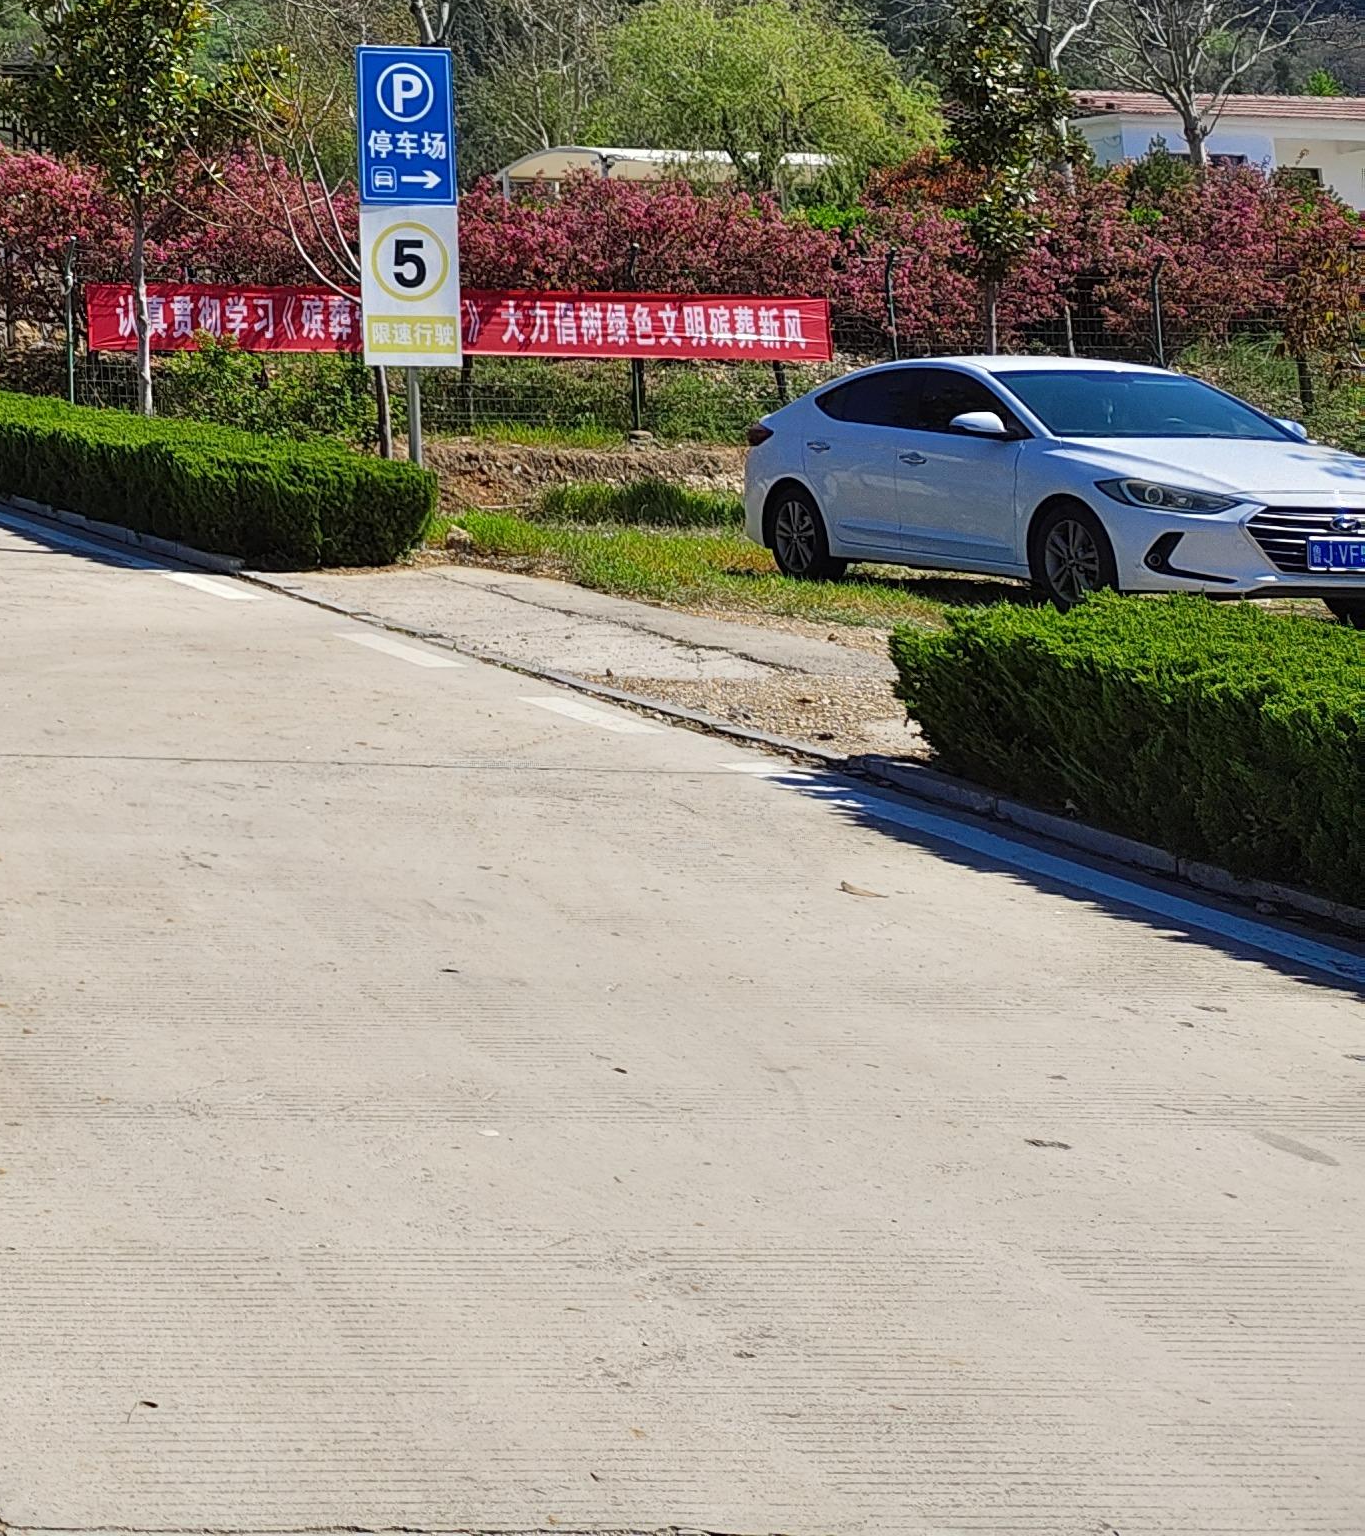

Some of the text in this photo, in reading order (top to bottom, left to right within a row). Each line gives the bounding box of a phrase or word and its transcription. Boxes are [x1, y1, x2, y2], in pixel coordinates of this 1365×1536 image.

[392, 73, 423, 113] P
[368, 129, 447, 160] 停车场
[393, 239, 426, 288] 5
[372, 322, 455, 346] 限速行驶
